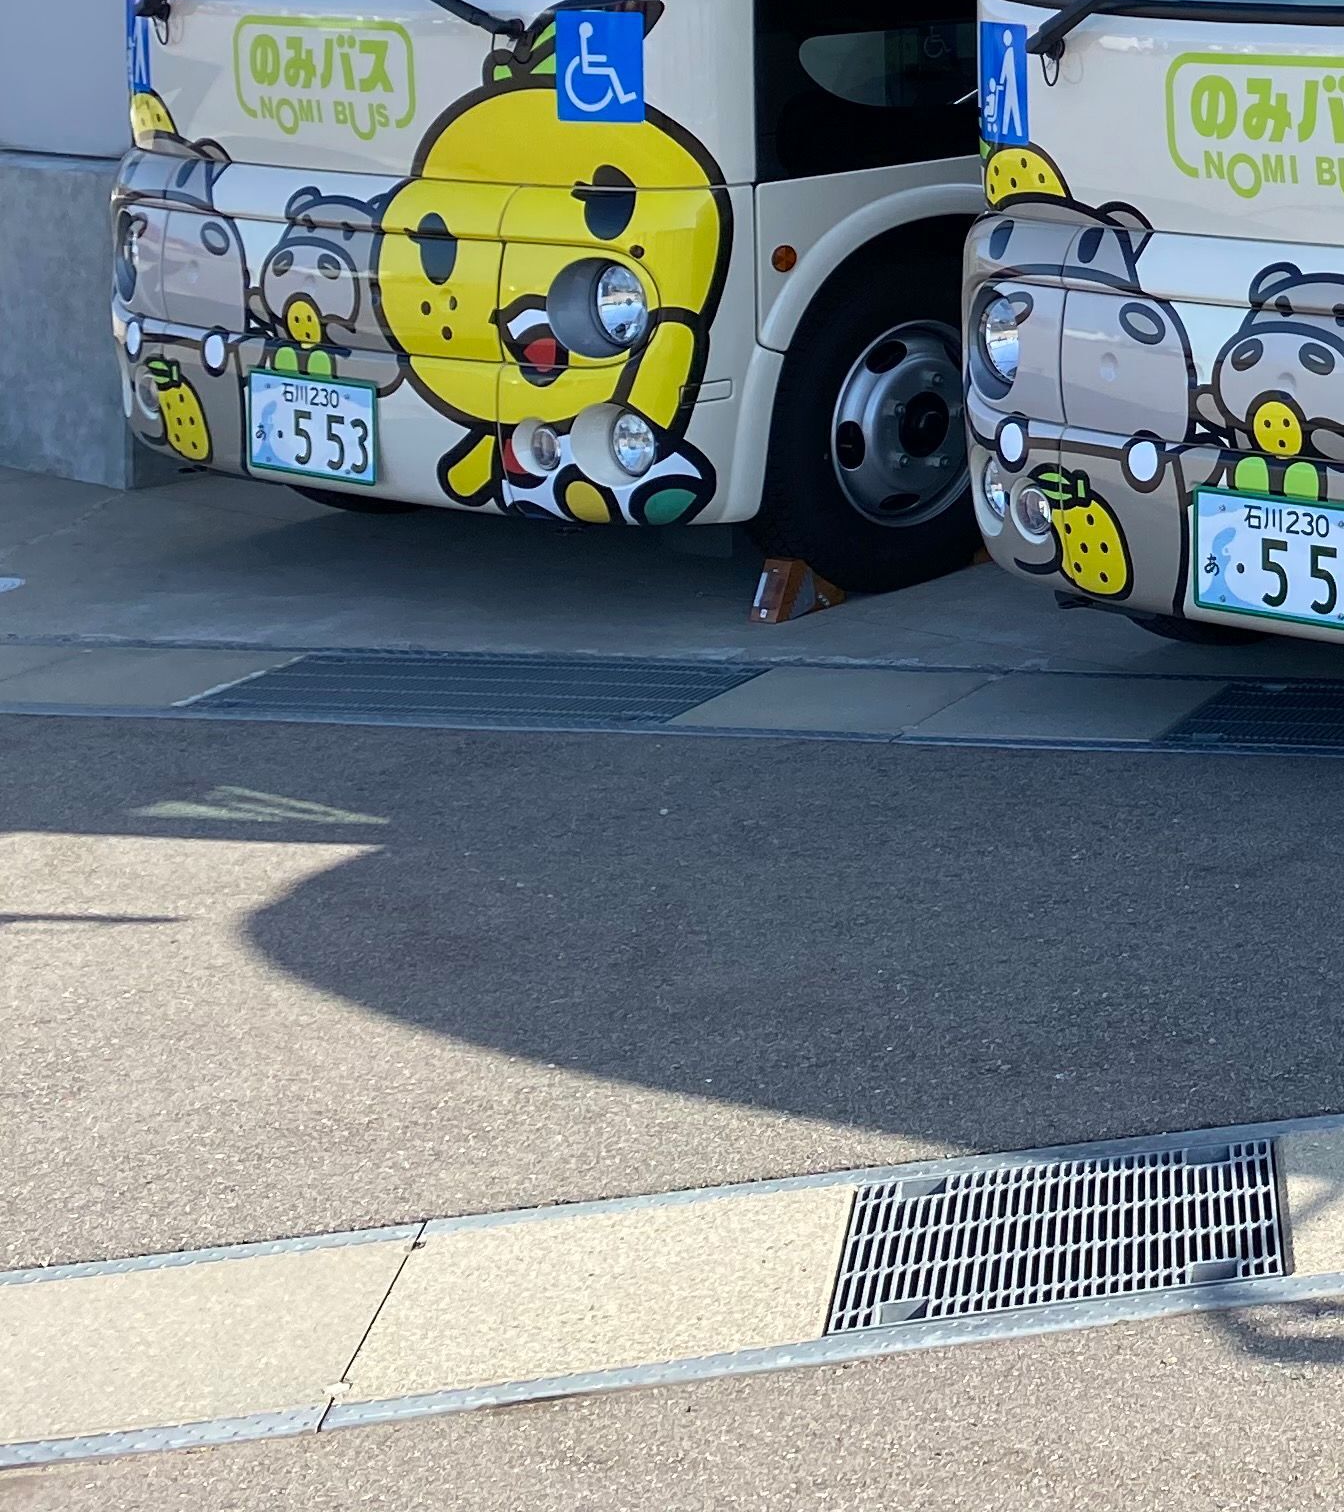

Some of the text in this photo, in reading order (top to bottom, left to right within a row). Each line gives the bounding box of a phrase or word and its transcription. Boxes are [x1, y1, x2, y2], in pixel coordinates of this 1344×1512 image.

[251, 34, 394, 93] のみバス
[259, 96, 390, 141] NOMI BUS
[1203, 150, 1299, 199] NOMI
[1243, 504, 1330, 538] 石川230
[1204, 553, 1220, 576] あ
